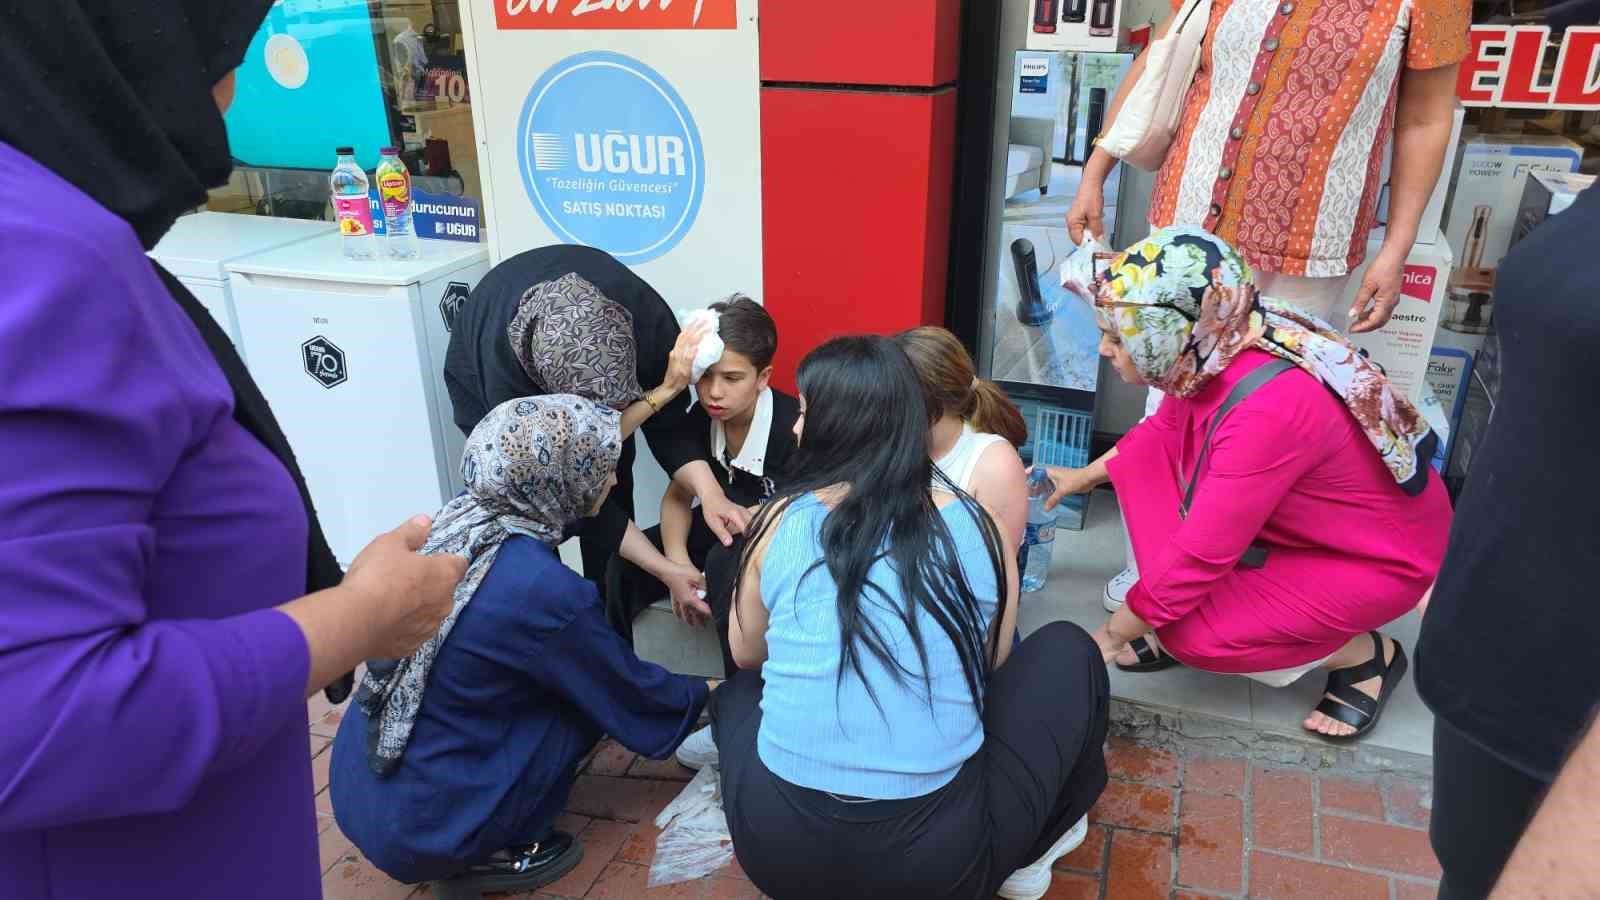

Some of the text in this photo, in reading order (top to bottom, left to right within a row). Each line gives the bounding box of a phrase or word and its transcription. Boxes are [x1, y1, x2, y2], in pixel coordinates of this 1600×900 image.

[574, 129, 686, 176] UĞUR
[563, 201, 665, 219] SATIŞ NOKTASI
[310, 351, 338, 374] 70
